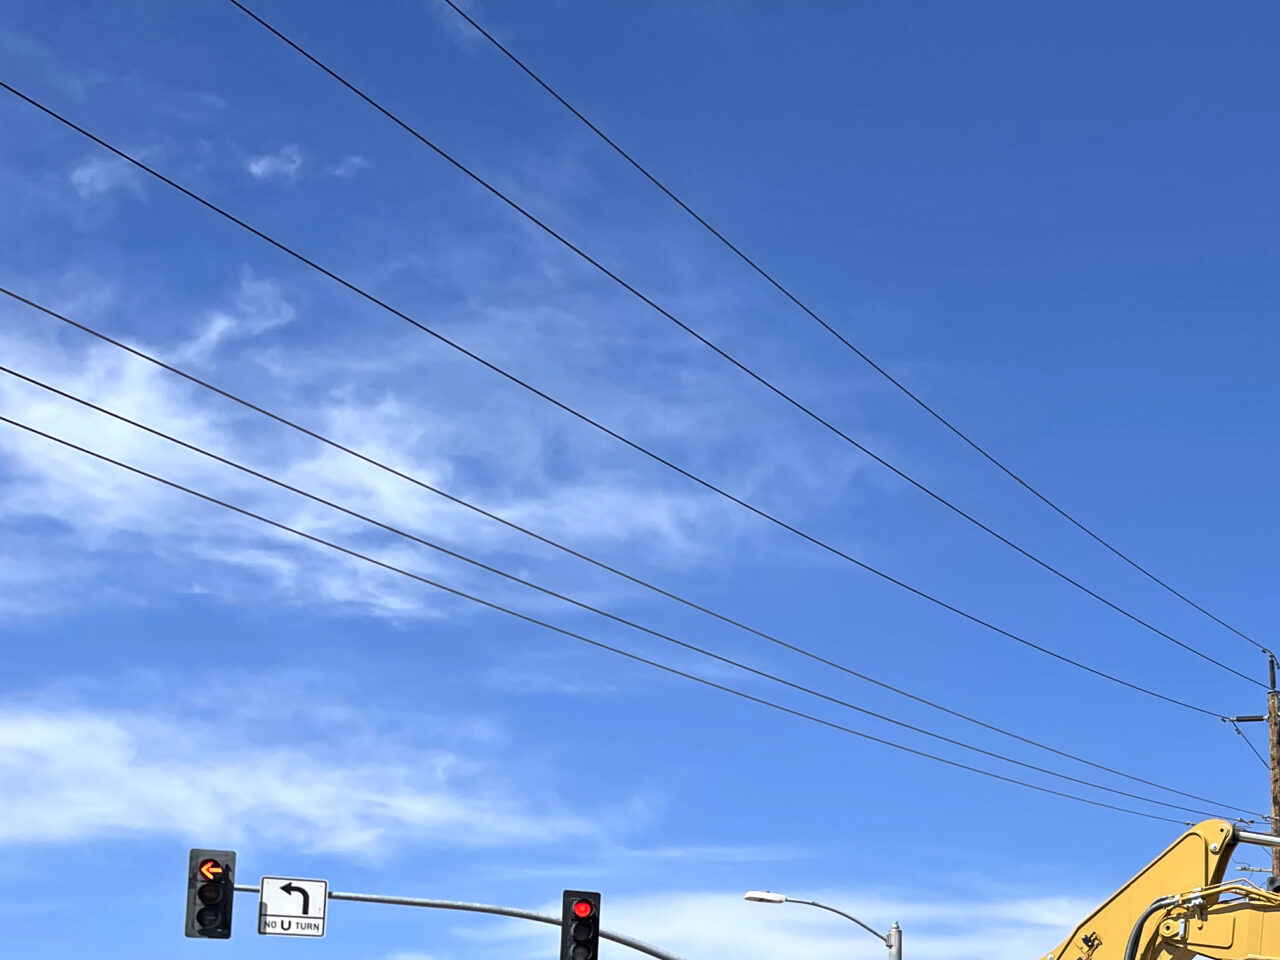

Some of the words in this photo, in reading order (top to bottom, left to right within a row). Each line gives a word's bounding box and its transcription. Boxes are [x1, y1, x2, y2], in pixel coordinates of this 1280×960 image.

[264, 920, 277, 929] NO
[280, 920, 291, 931] U
[295, 921, 320, 932] TURN
